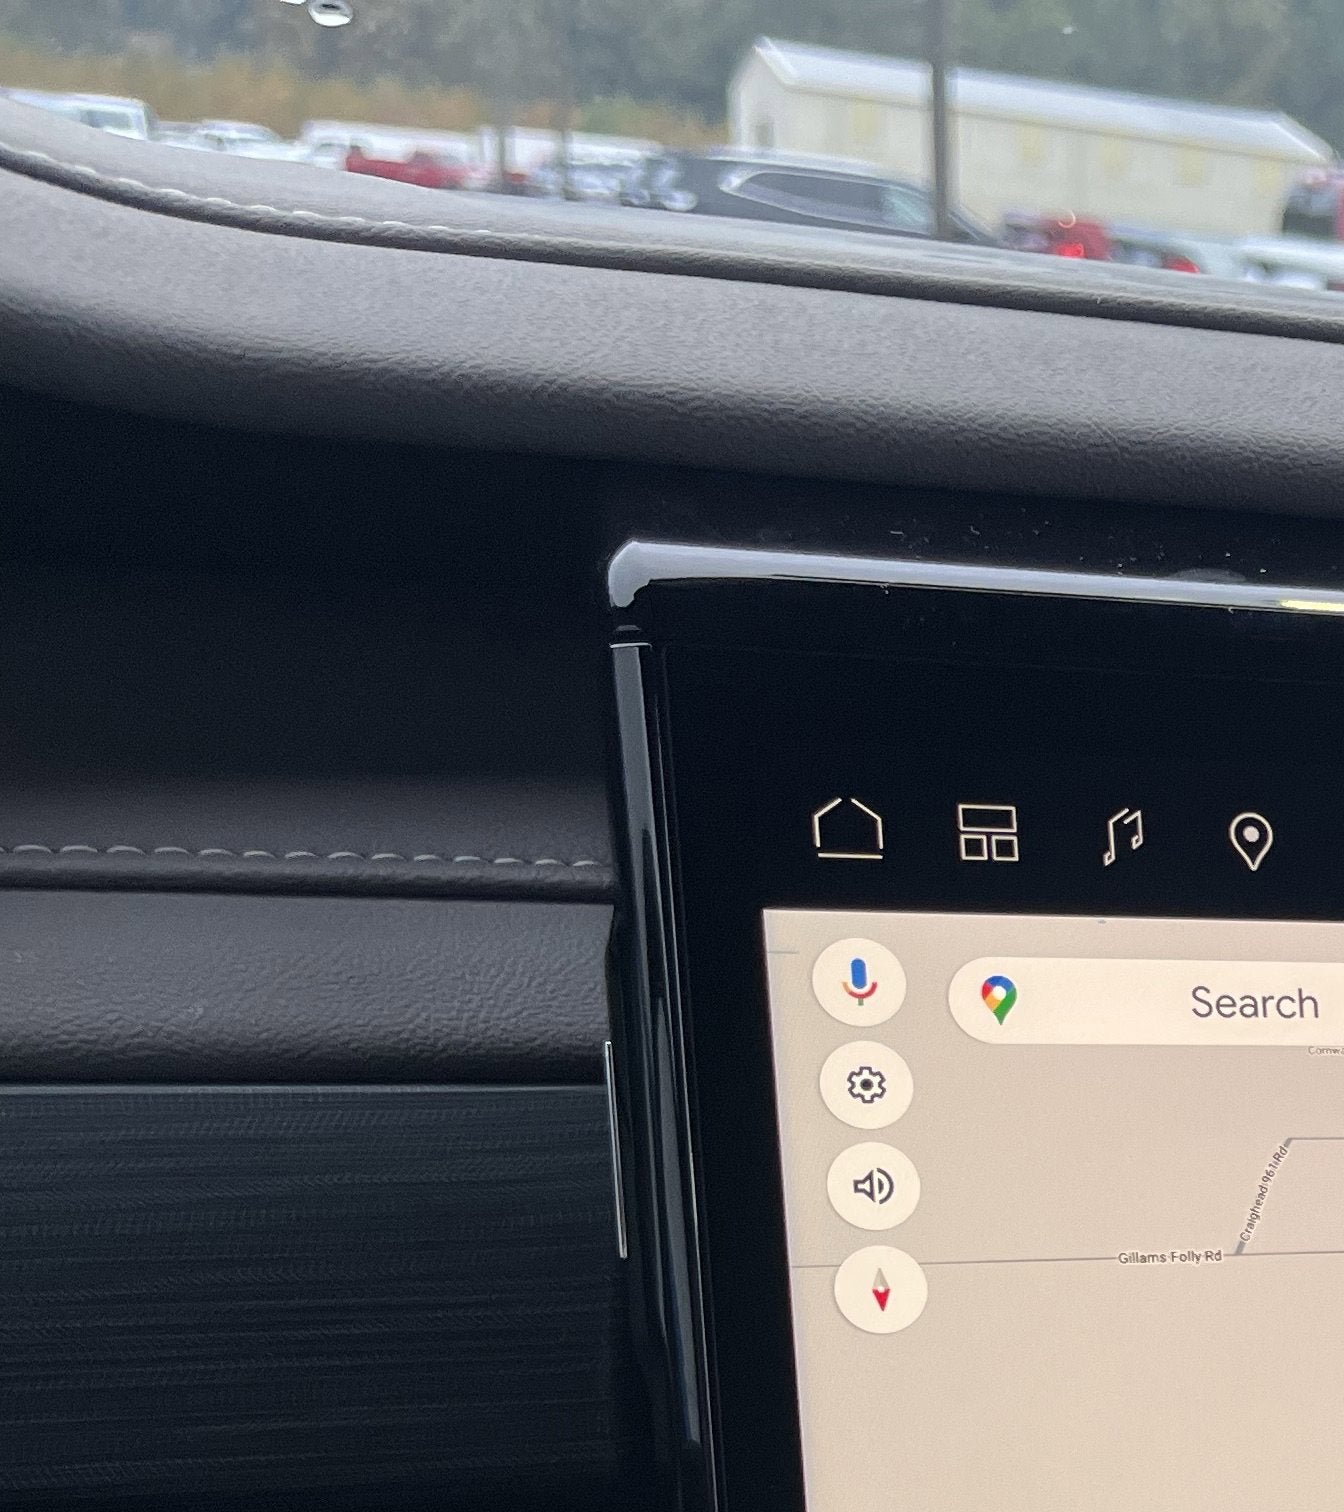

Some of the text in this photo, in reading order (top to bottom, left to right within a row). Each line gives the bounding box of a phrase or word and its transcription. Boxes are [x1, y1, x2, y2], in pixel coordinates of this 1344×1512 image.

[1191, 985, 1319, 1019] Search
[1240, 1145, 1288, 1242] Craighead 961 Rd
[1118, 1250, 1223, 1265] Gillams Folly Rd
